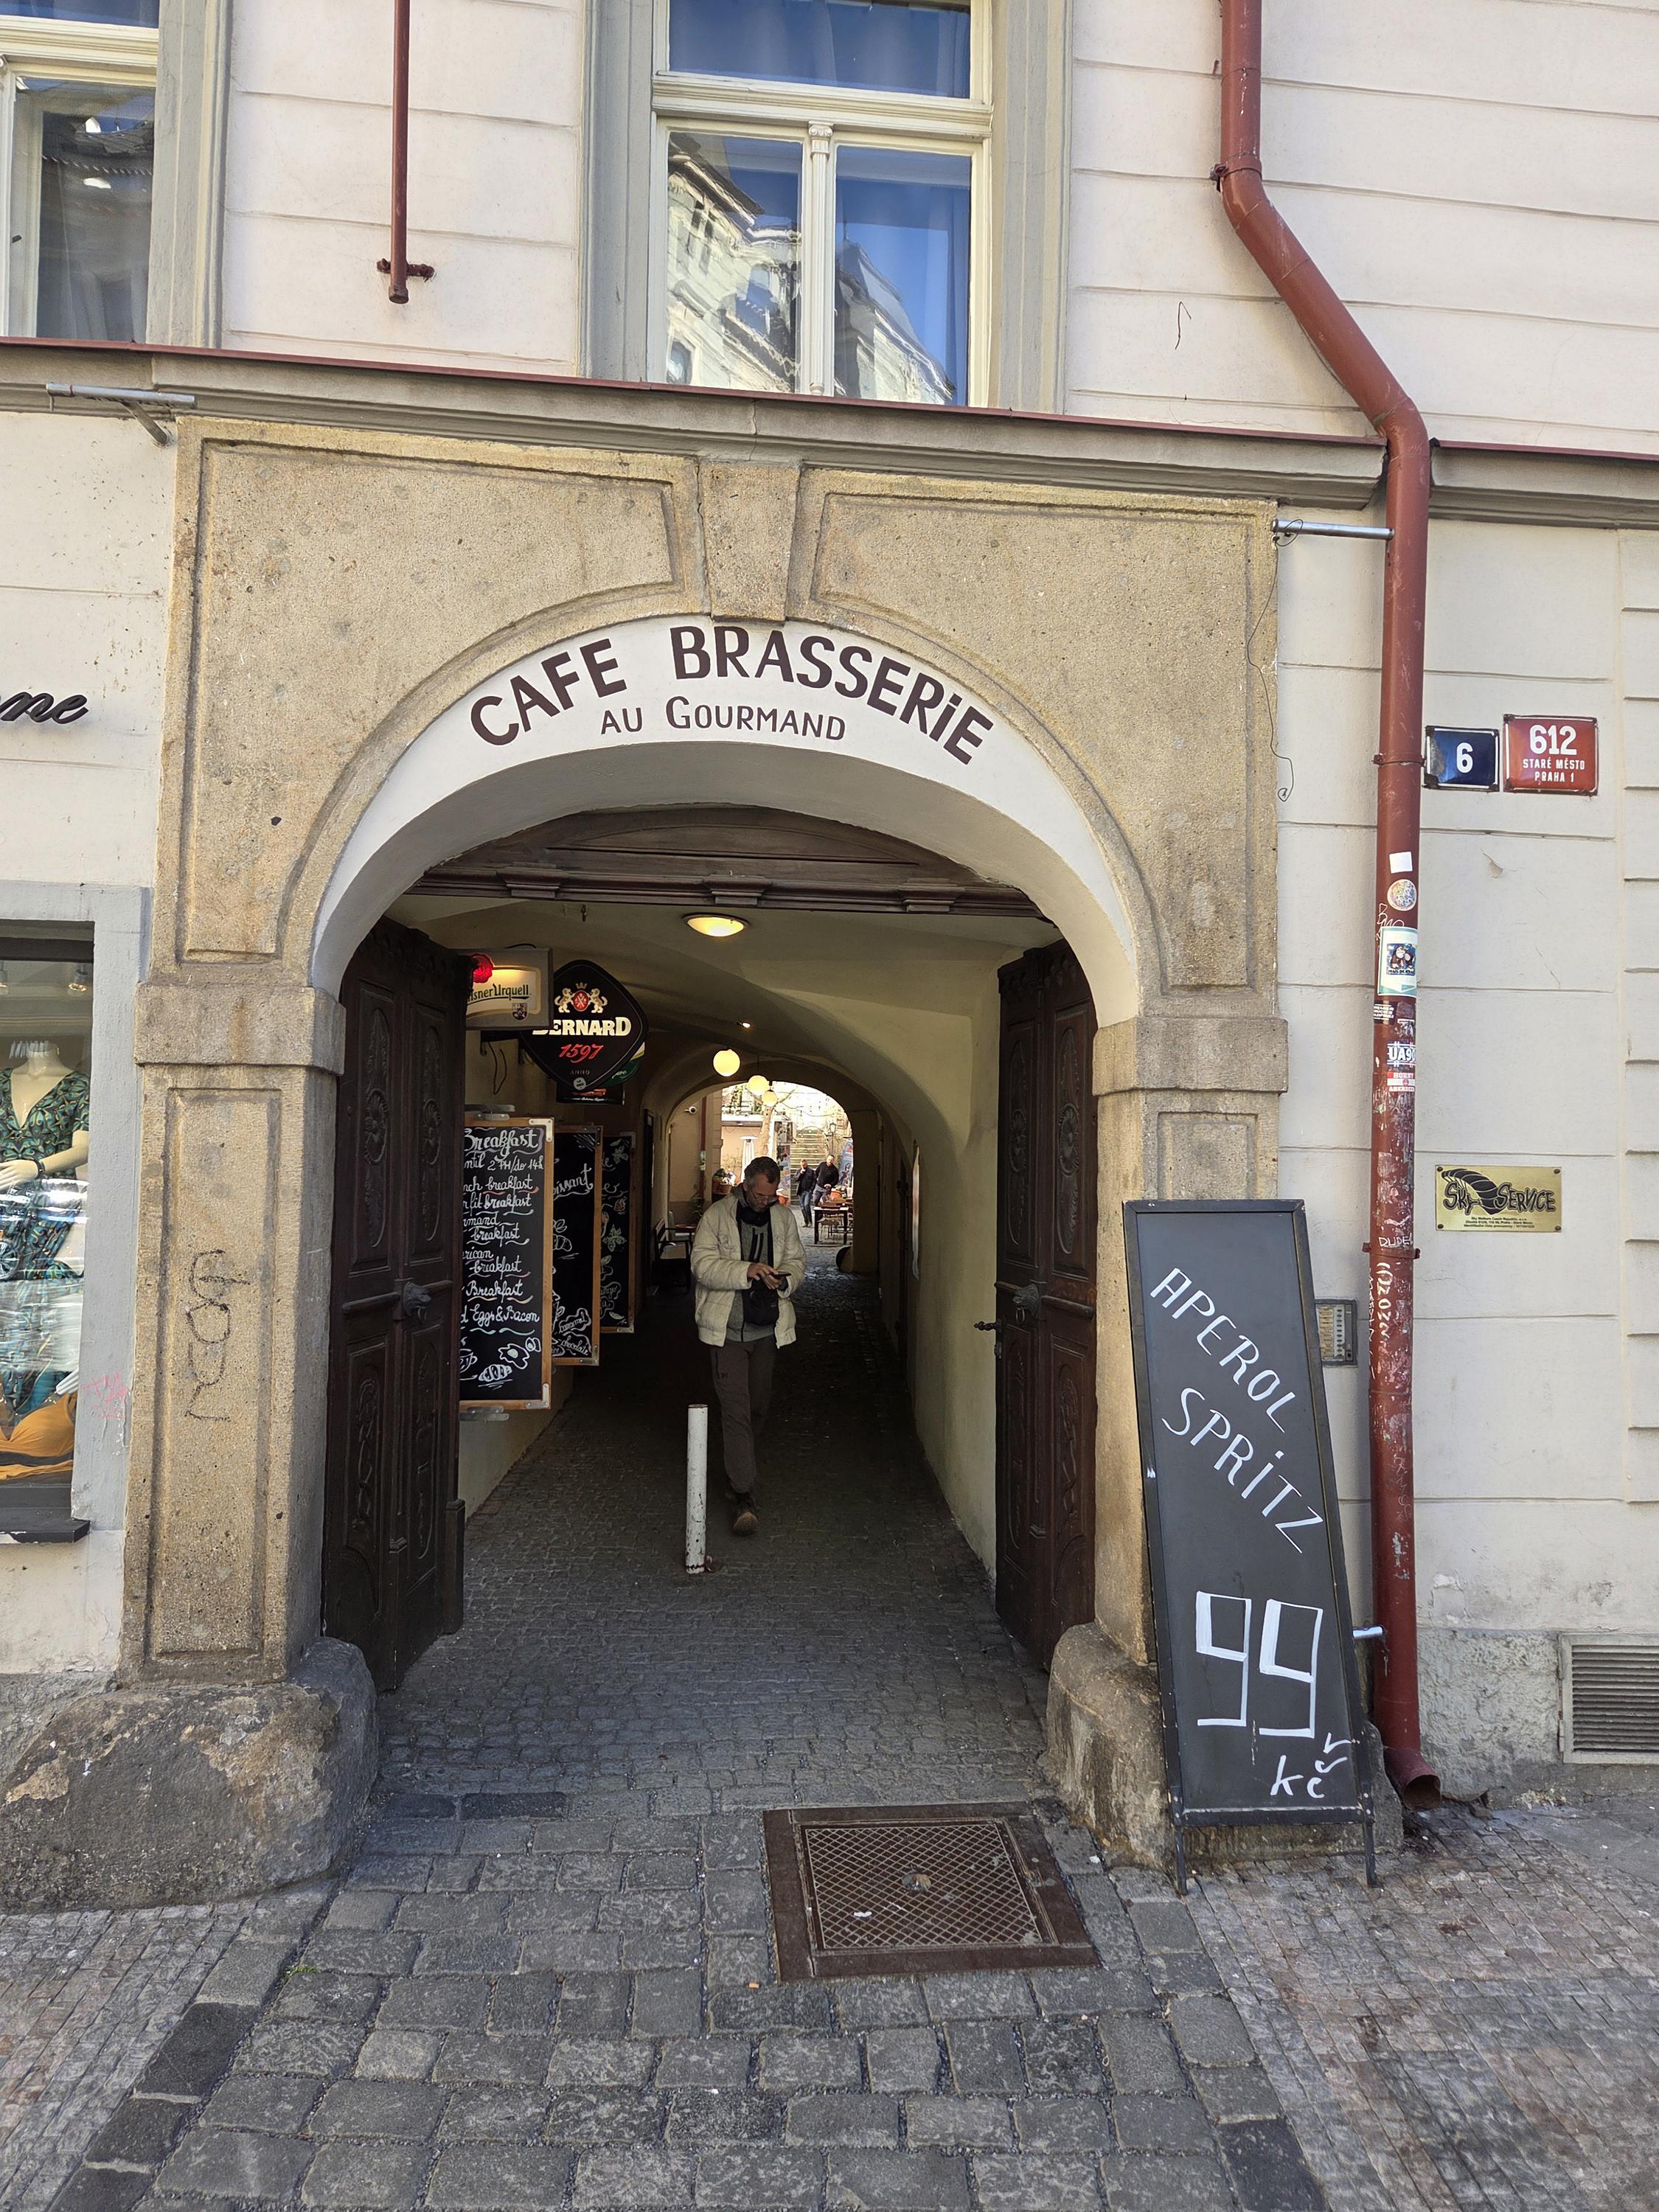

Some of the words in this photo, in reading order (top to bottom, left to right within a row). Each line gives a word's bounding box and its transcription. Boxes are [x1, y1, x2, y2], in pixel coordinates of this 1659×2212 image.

[471, 638, 627, 745] CAFE
[600, 706, 644, 736] AU
[1529, 725, 1577, 756] 612
[1456, 742, 1473, 773] 6
[1523, 757, 1551, 768] STARÉ
[1534, 771, 1565, 782] PRAHA
[1571, 772, 1574, 782] 1
[467, 988, 493, 1002] lsner
[493, 983, 529, 1001] Urquell
[559, 1043, 604, 1062] 1597
[464, 1128, 538, 1161] Breakfast
[464, 1152, 485, 1169] ntil
[487, 1160, 496, 1171] 2
[485, 1173, 533, 1194] breakfast
[484, 1193, 532, 1211] breakfast
[1494, 1182, 1557, 1213] SERVICE
[470, 1222, 521, 1248] breakfast
[470, 1255, 522, 1280] breakfast
[466, 1279, 524, 1304] Breakfast
[1150, 1267, 1296, 1433] APEROL
[1196, 1590, 1324, 1739] 99
